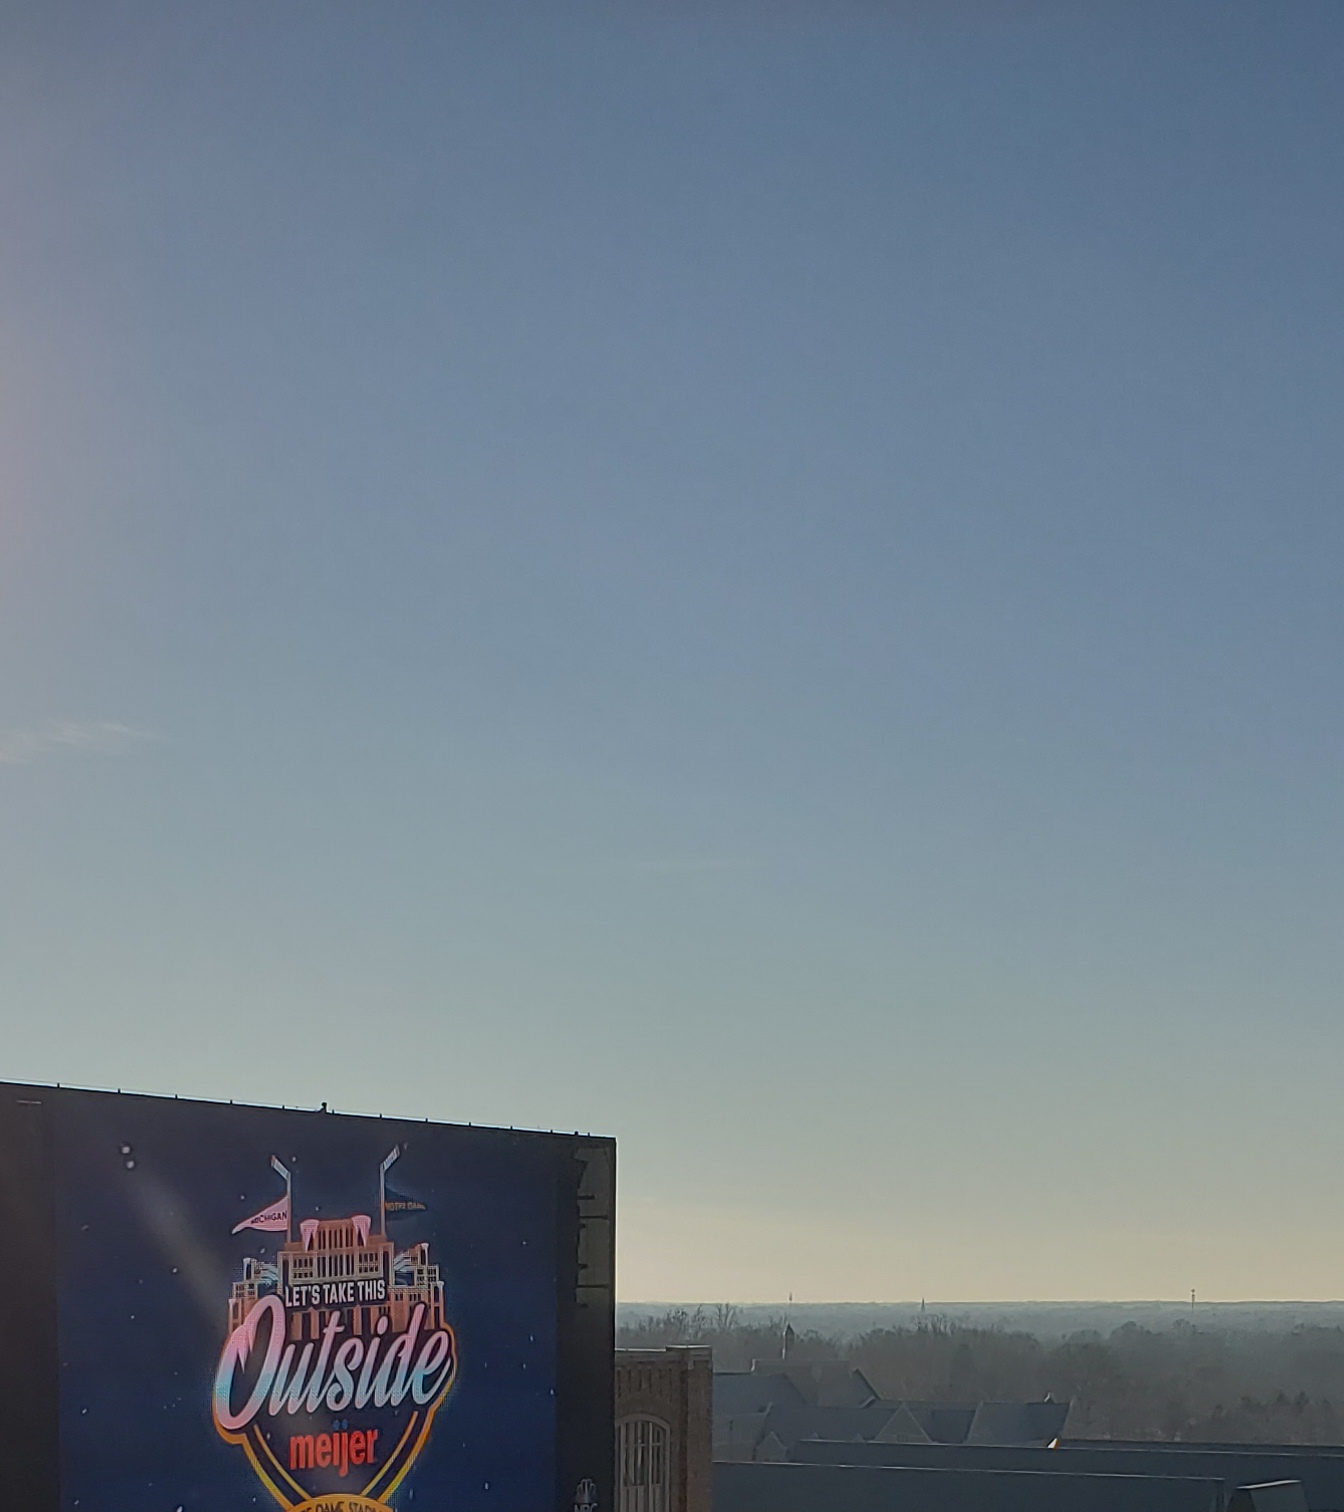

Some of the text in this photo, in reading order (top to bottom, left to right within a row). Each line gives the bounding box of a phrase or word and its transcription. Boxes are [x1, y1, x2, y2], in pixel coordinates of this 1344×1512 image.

[285, 1279, 386, 1307] LET'S TAKE THIS
[214, 1294, 452, 1430] Outside
[289, 1419, 379, 1477] meijer
